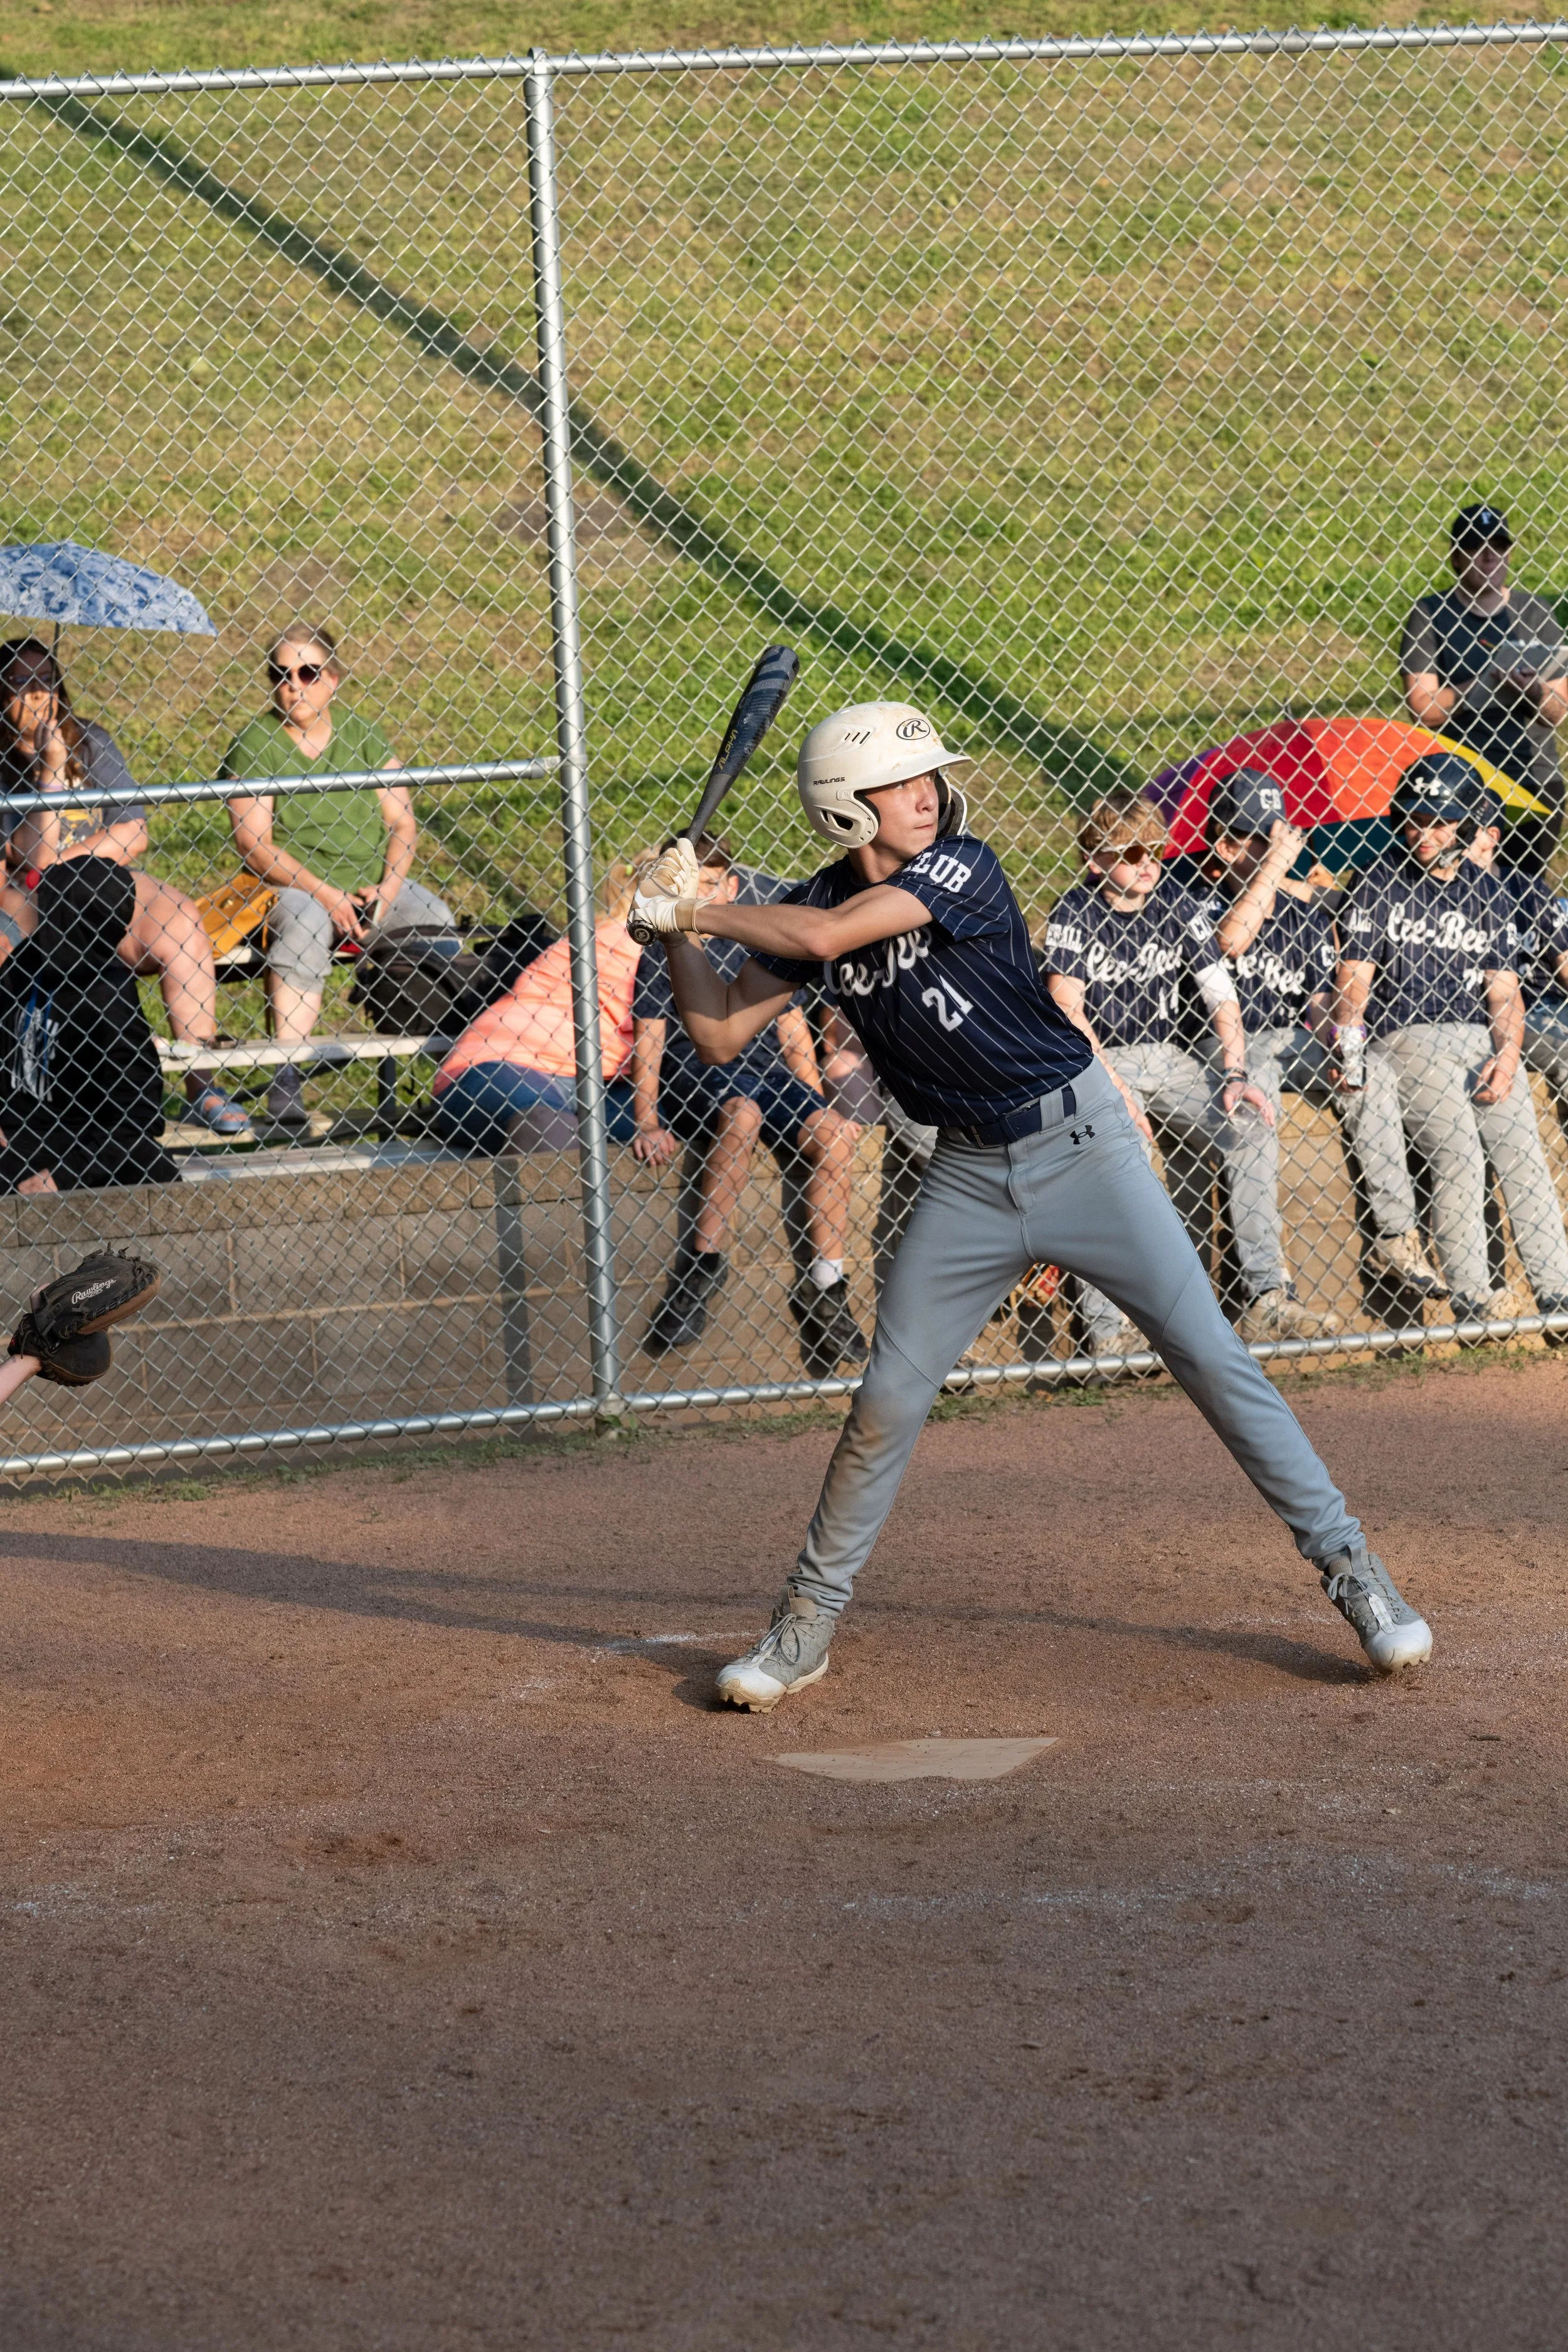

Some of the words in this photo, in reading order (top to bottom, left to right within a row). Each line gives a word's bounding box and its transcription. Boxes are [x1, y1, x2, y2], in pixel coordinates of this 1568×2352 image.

[717, 728, 739, 771] ALPHA
[813, 776, 845, 786] RAWLINGS
[823, 924, 932, 997] Cee-ee
[921, 973, 973, 1032] 21
[71, 1278, 117, 1305] Rawlings
